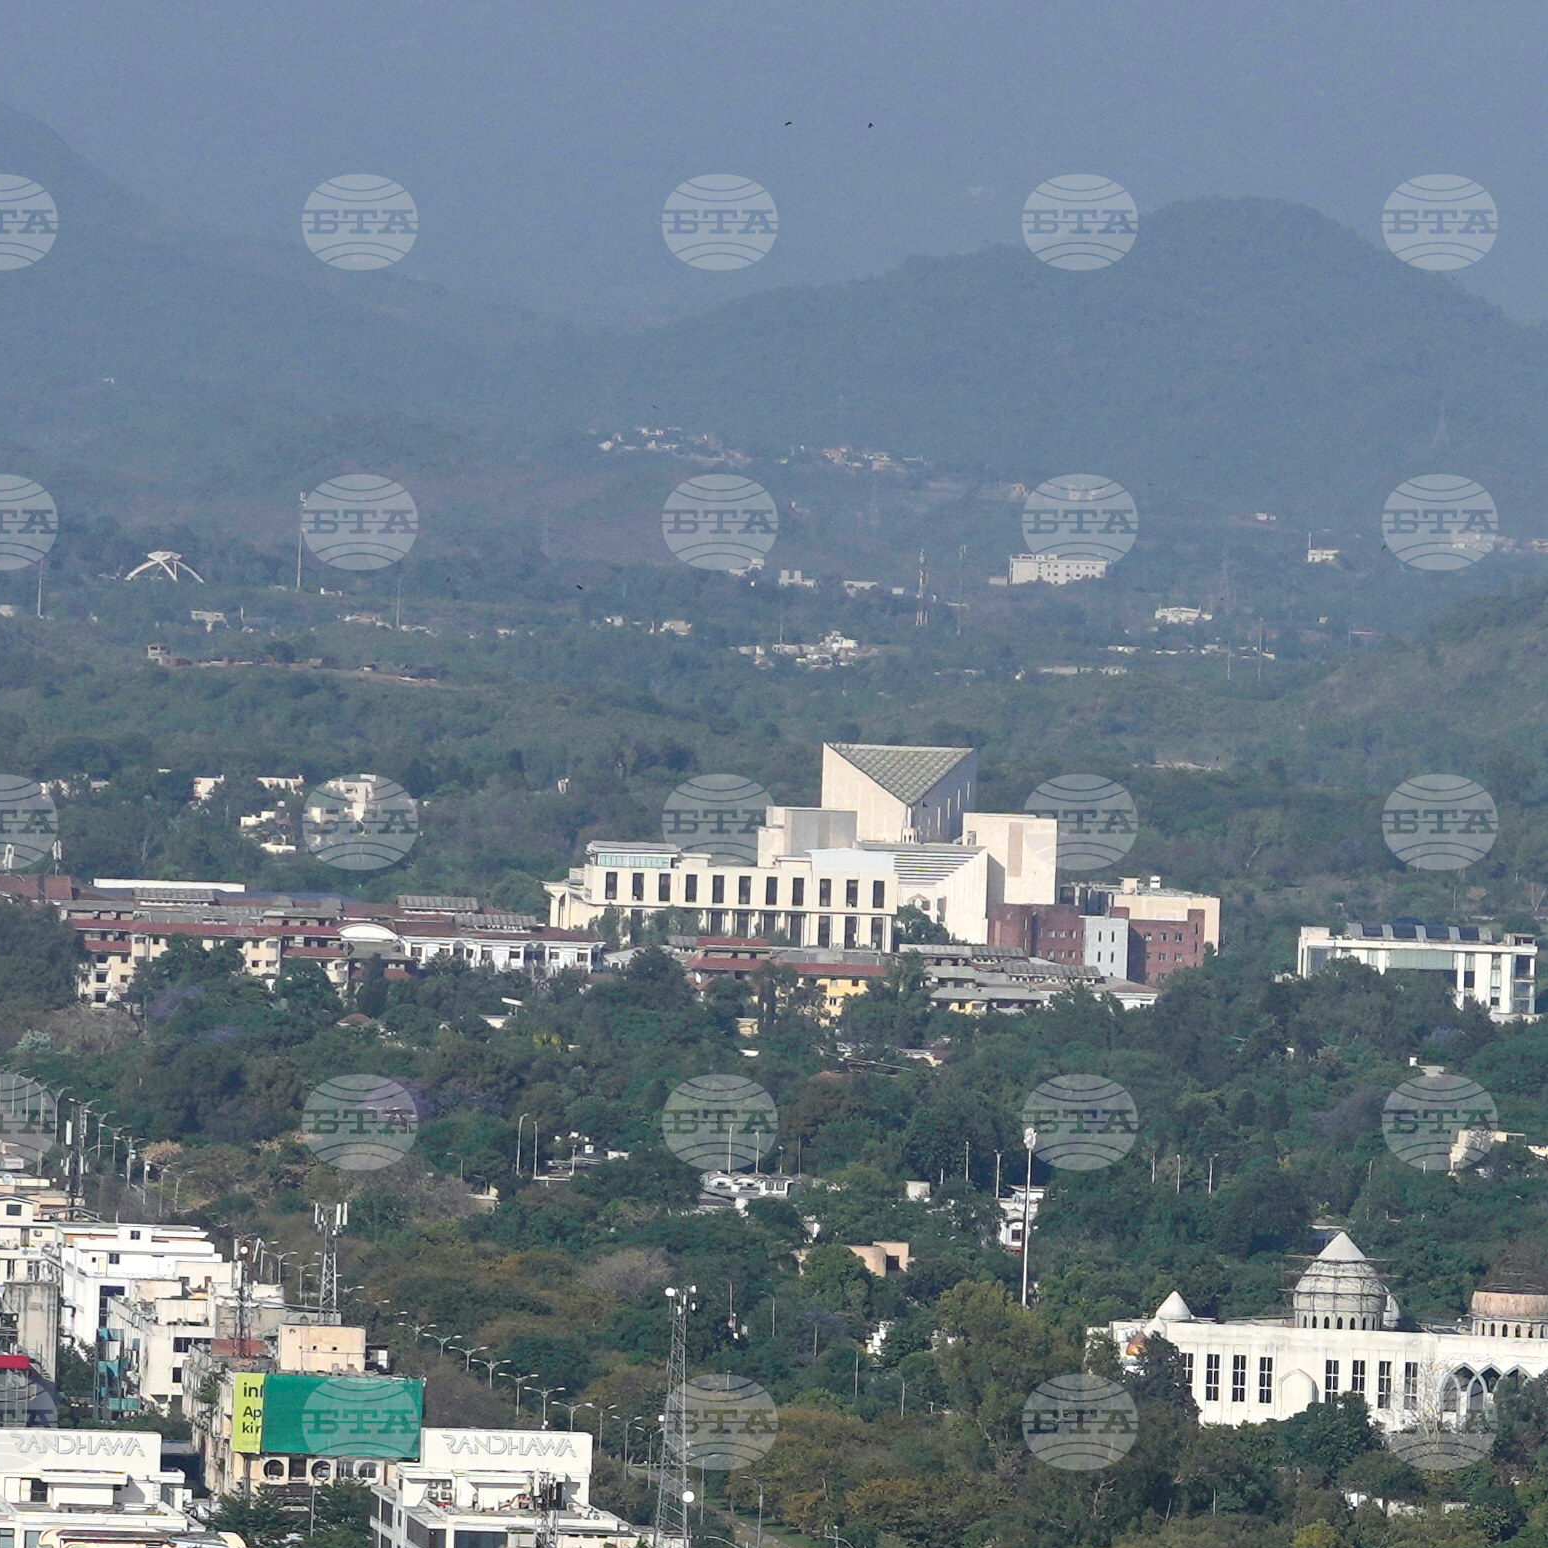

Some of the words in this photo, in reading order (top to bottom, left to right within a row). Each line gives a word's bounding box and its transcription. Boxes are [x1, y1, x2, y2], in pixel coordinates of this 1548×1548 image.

[243, 1382, 263, 1398] in
[10, 1433, 145, 1457] RANDHAWA
[440, 1434, 577, 1458] RANDHAWA
